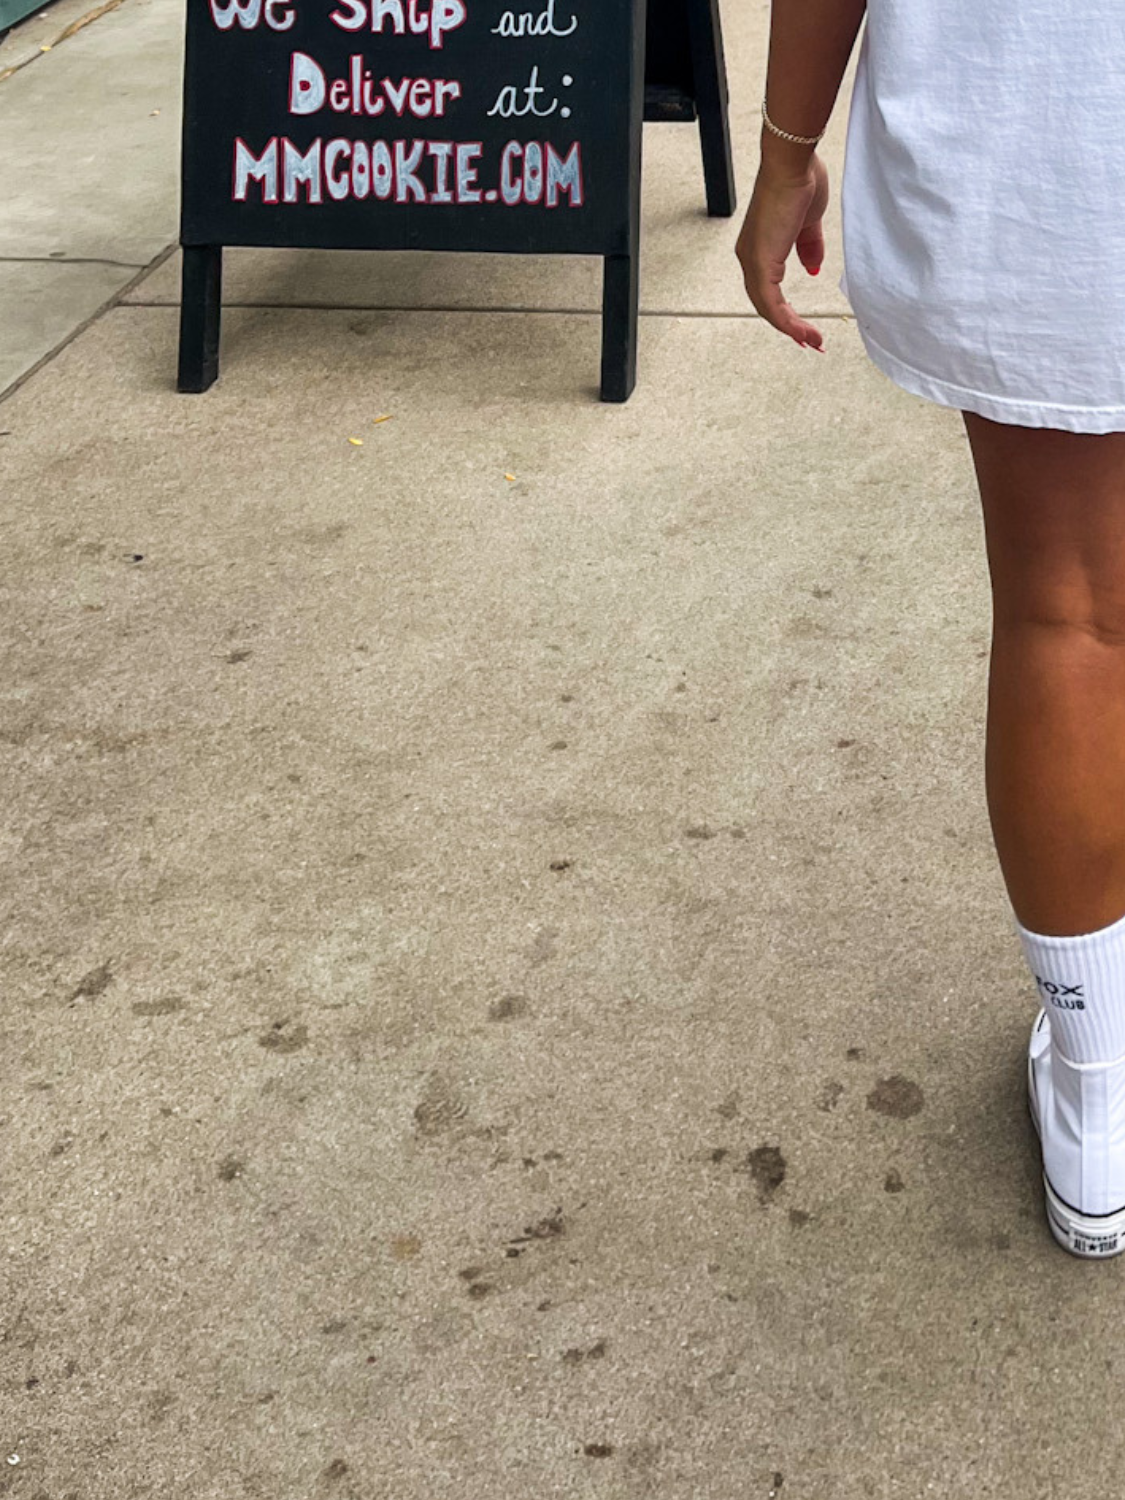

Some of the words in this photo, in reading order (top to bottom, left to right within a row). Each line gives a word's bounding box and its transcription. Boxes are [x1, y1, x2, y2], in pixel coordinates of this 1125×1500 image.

[289, 52, 462, 117] Deliver
[487, 66, 574, 118] at:
[233, 137, 583, 208] MMCOOKIE.COM
[1051, 996, 1085, 1010] CLUB
